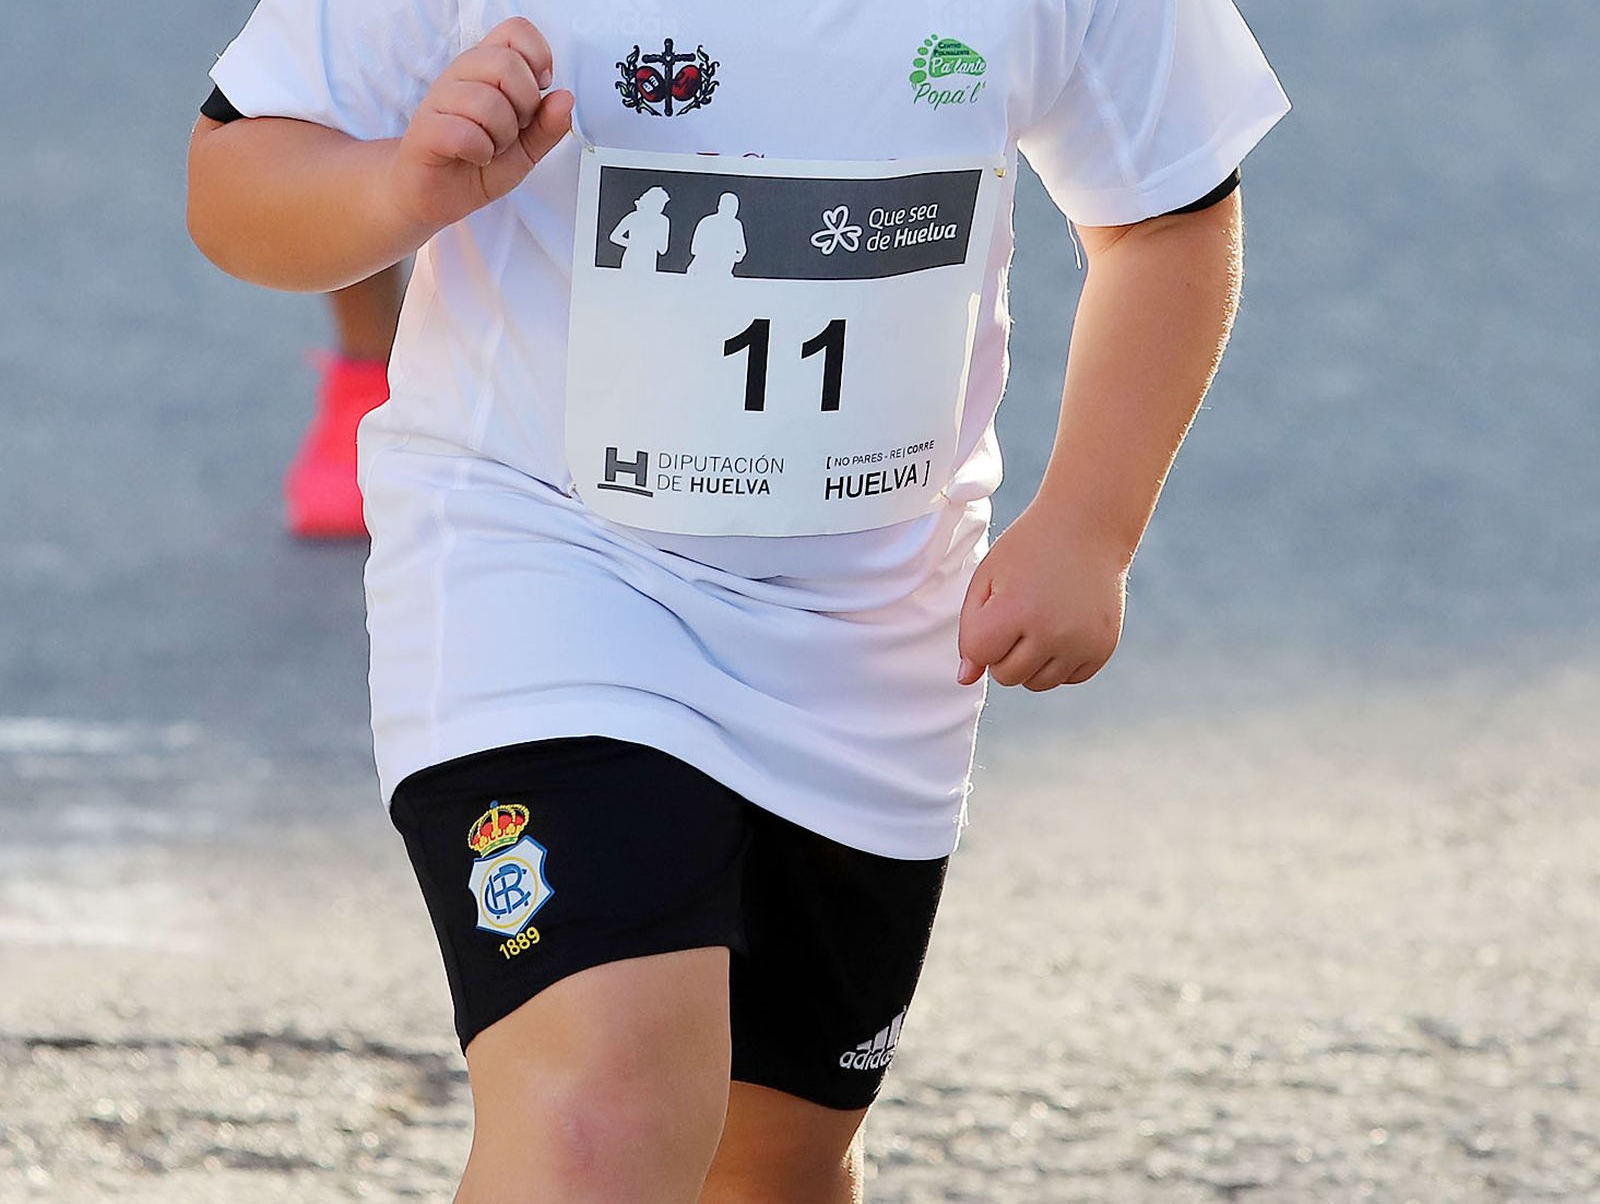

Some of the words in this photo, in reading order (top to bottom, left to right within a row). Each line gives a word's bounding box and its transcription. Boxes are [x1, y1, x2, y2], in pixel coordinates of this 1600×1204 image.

[868, 207, 905, 230] Que
[908, 203, 939, 223] sea
[866, 230, 890, 252] de
[894, 222, 958, 249] Huelva
[723, 318, 847, 413] 11
[658, 452, 785, 474] DIPUTACIÓN
[834, 456, 850, 467] NO
[852, 452, 883, 465] PARES
[657, 474, 682, 492] DE
[690, 477, 771, 495] HUELVA
[499, 926, 541, 960] 1889
